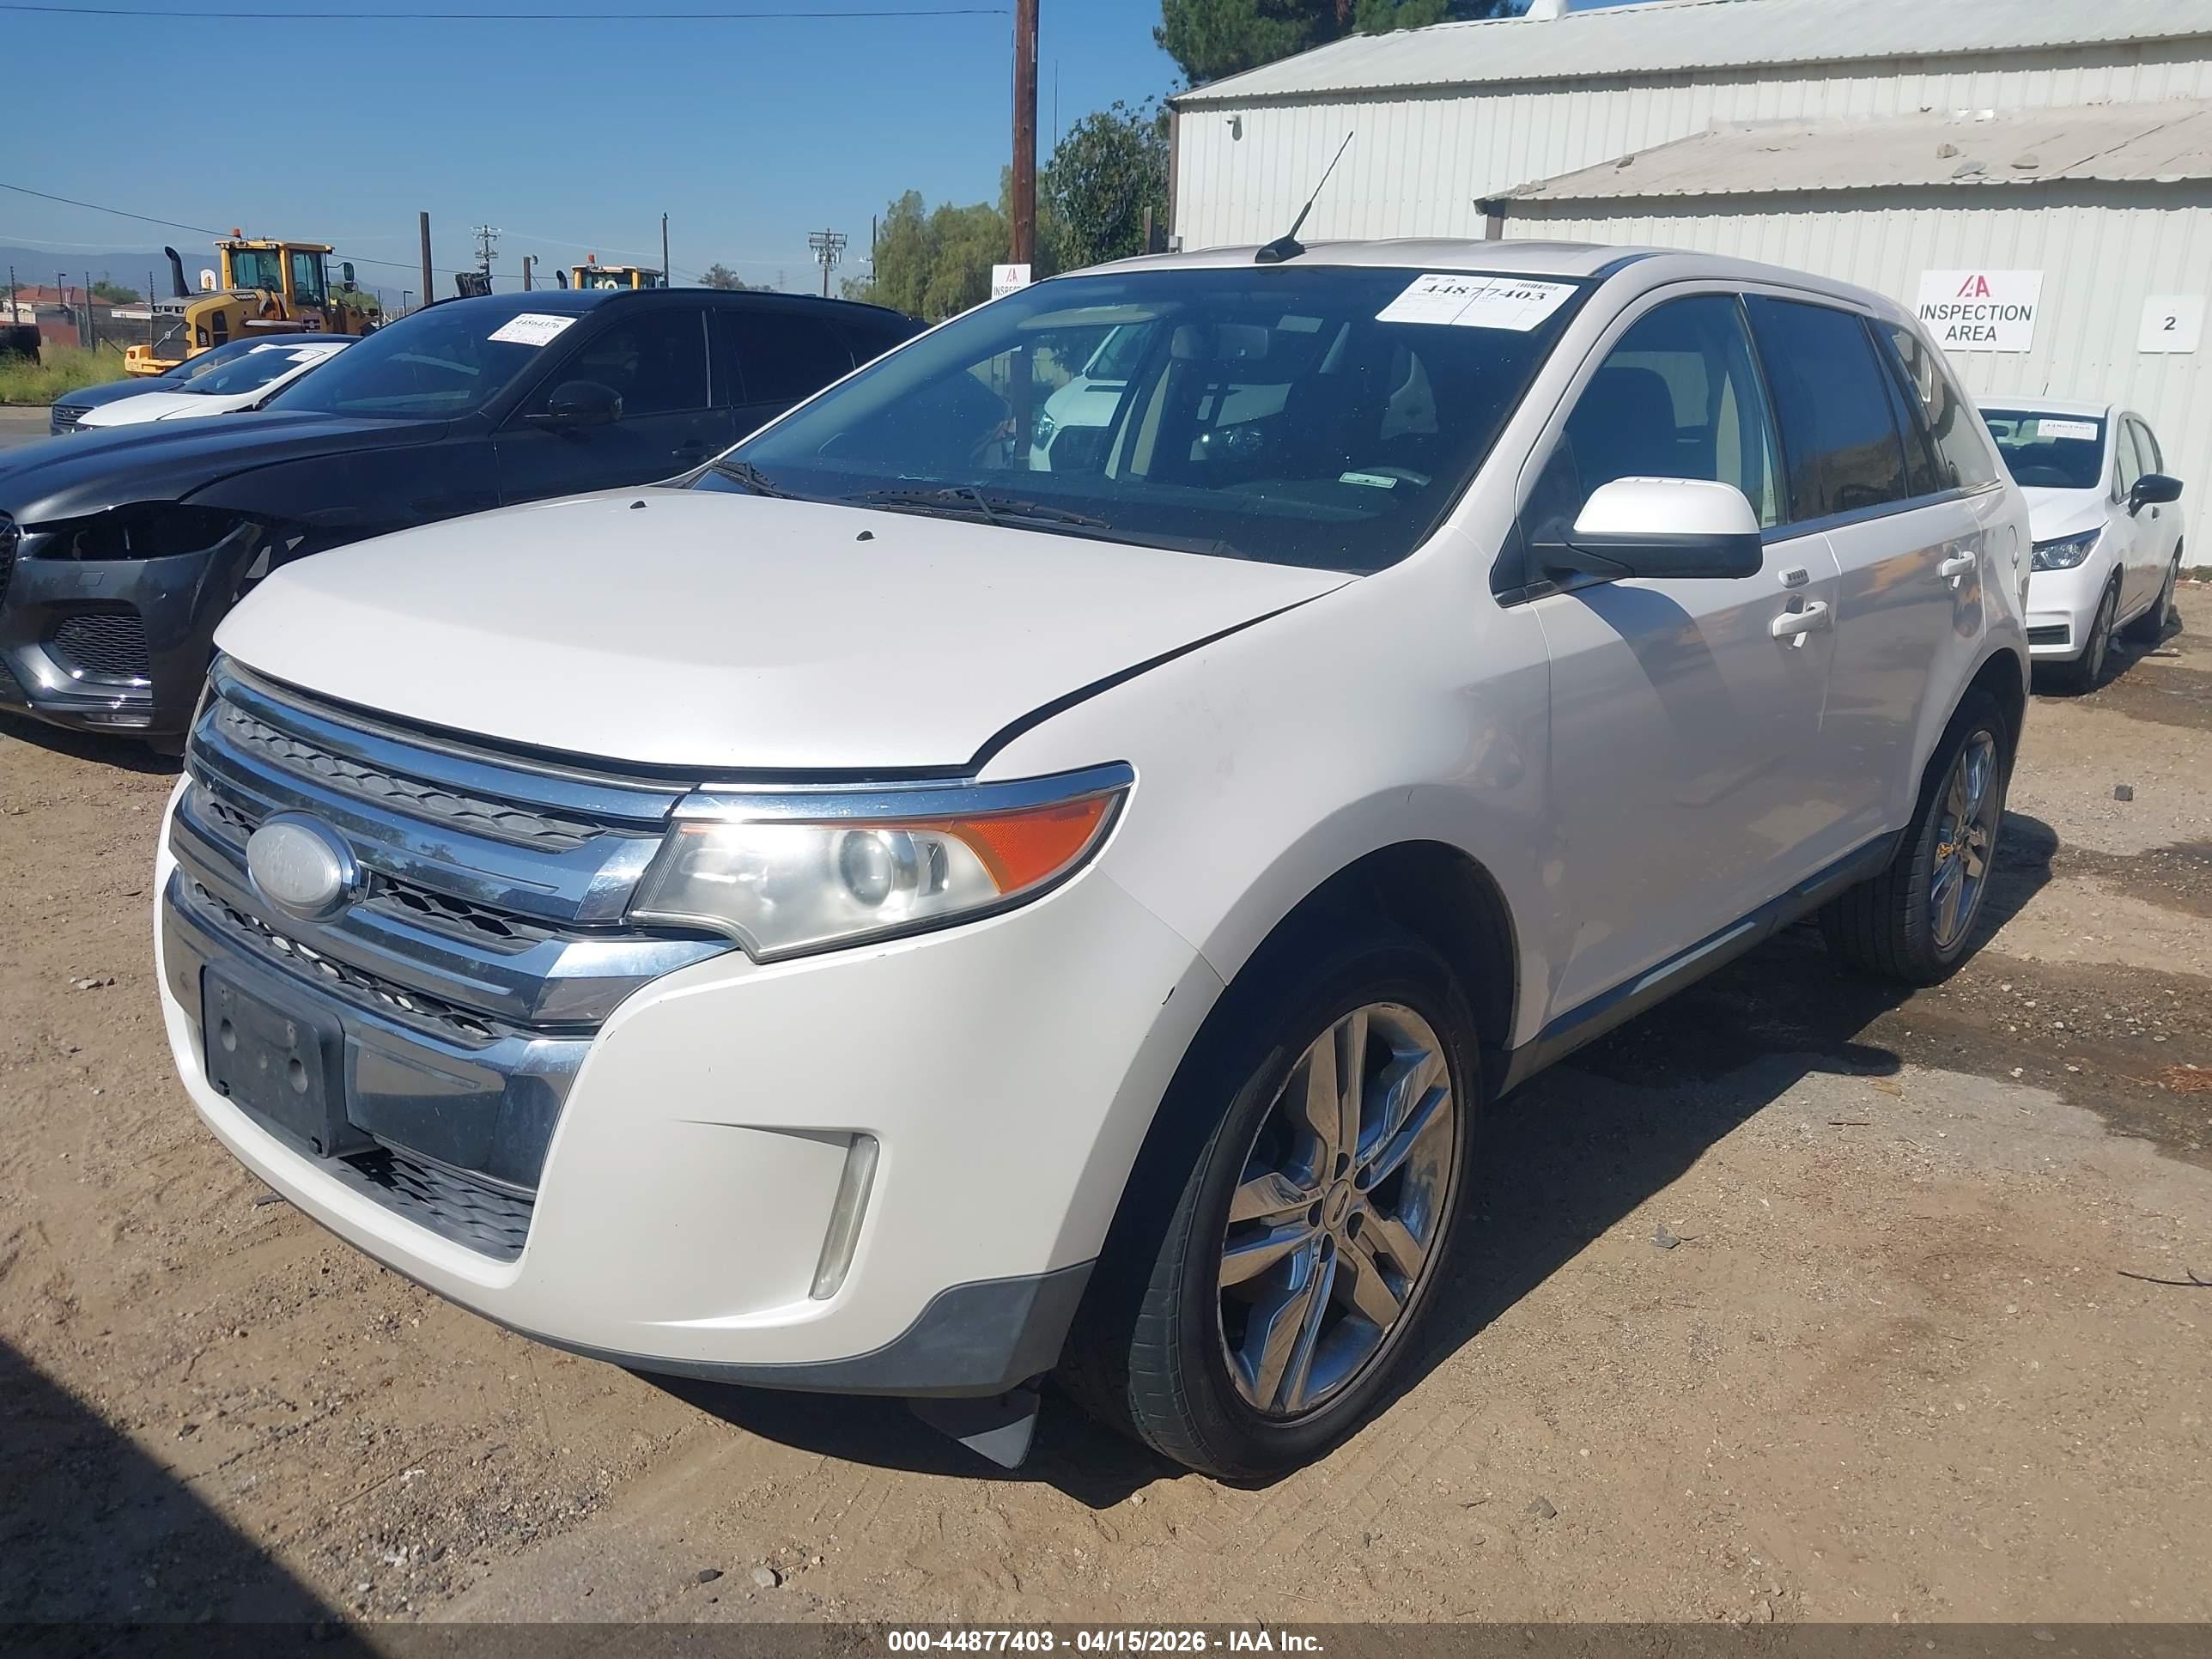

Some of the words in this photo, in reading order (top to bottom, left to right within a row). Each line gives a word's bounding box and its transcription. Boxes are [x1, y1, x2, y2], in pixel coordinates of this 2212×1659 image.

[1421, 283, 1547, 301] 44877403
[1919, 304, 2033, 321] INSPECTION
[2163, 315, 2177, 331] 2
[1945, 325, 1997, 342] AREA
